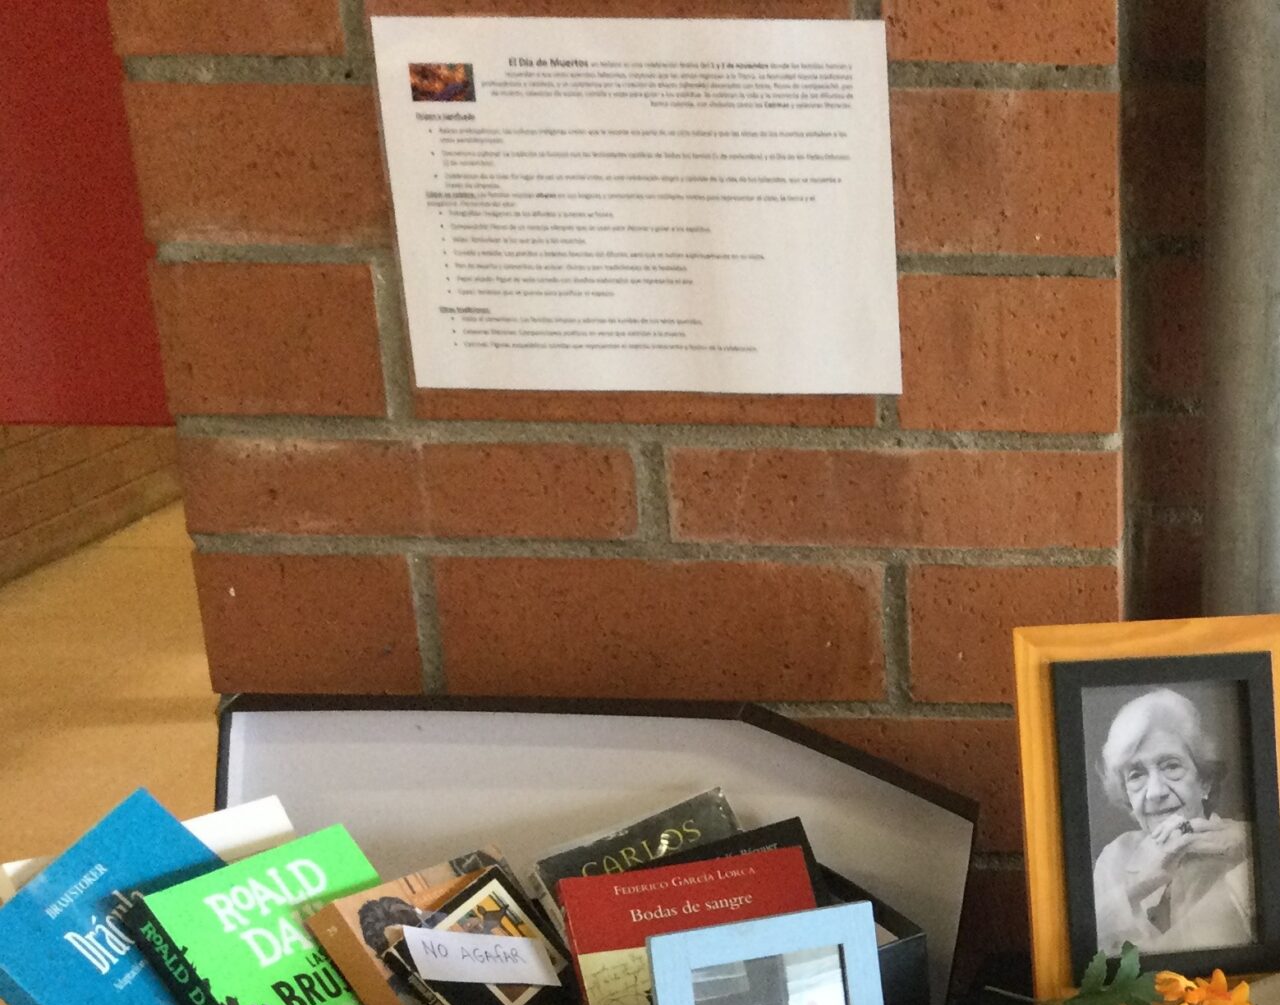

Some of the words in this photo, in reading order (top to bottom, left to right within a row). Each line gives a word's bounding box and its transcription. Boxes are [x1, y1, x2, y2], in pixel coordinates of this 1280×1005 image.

[549, 56, 589, 68] Muertos
[581, 819, 702, 877] CARLOS
[67, 863, 108, 898] STOKER
[204, 859, 327, 933] ROALD
[629, 905, 678, 923] Bodas
[682, 900, 702, 914] de
[705, 893, 754, 912] sangre
[140, 921, 189, 983] ROALD
[421, 940, 449, 959] NO
